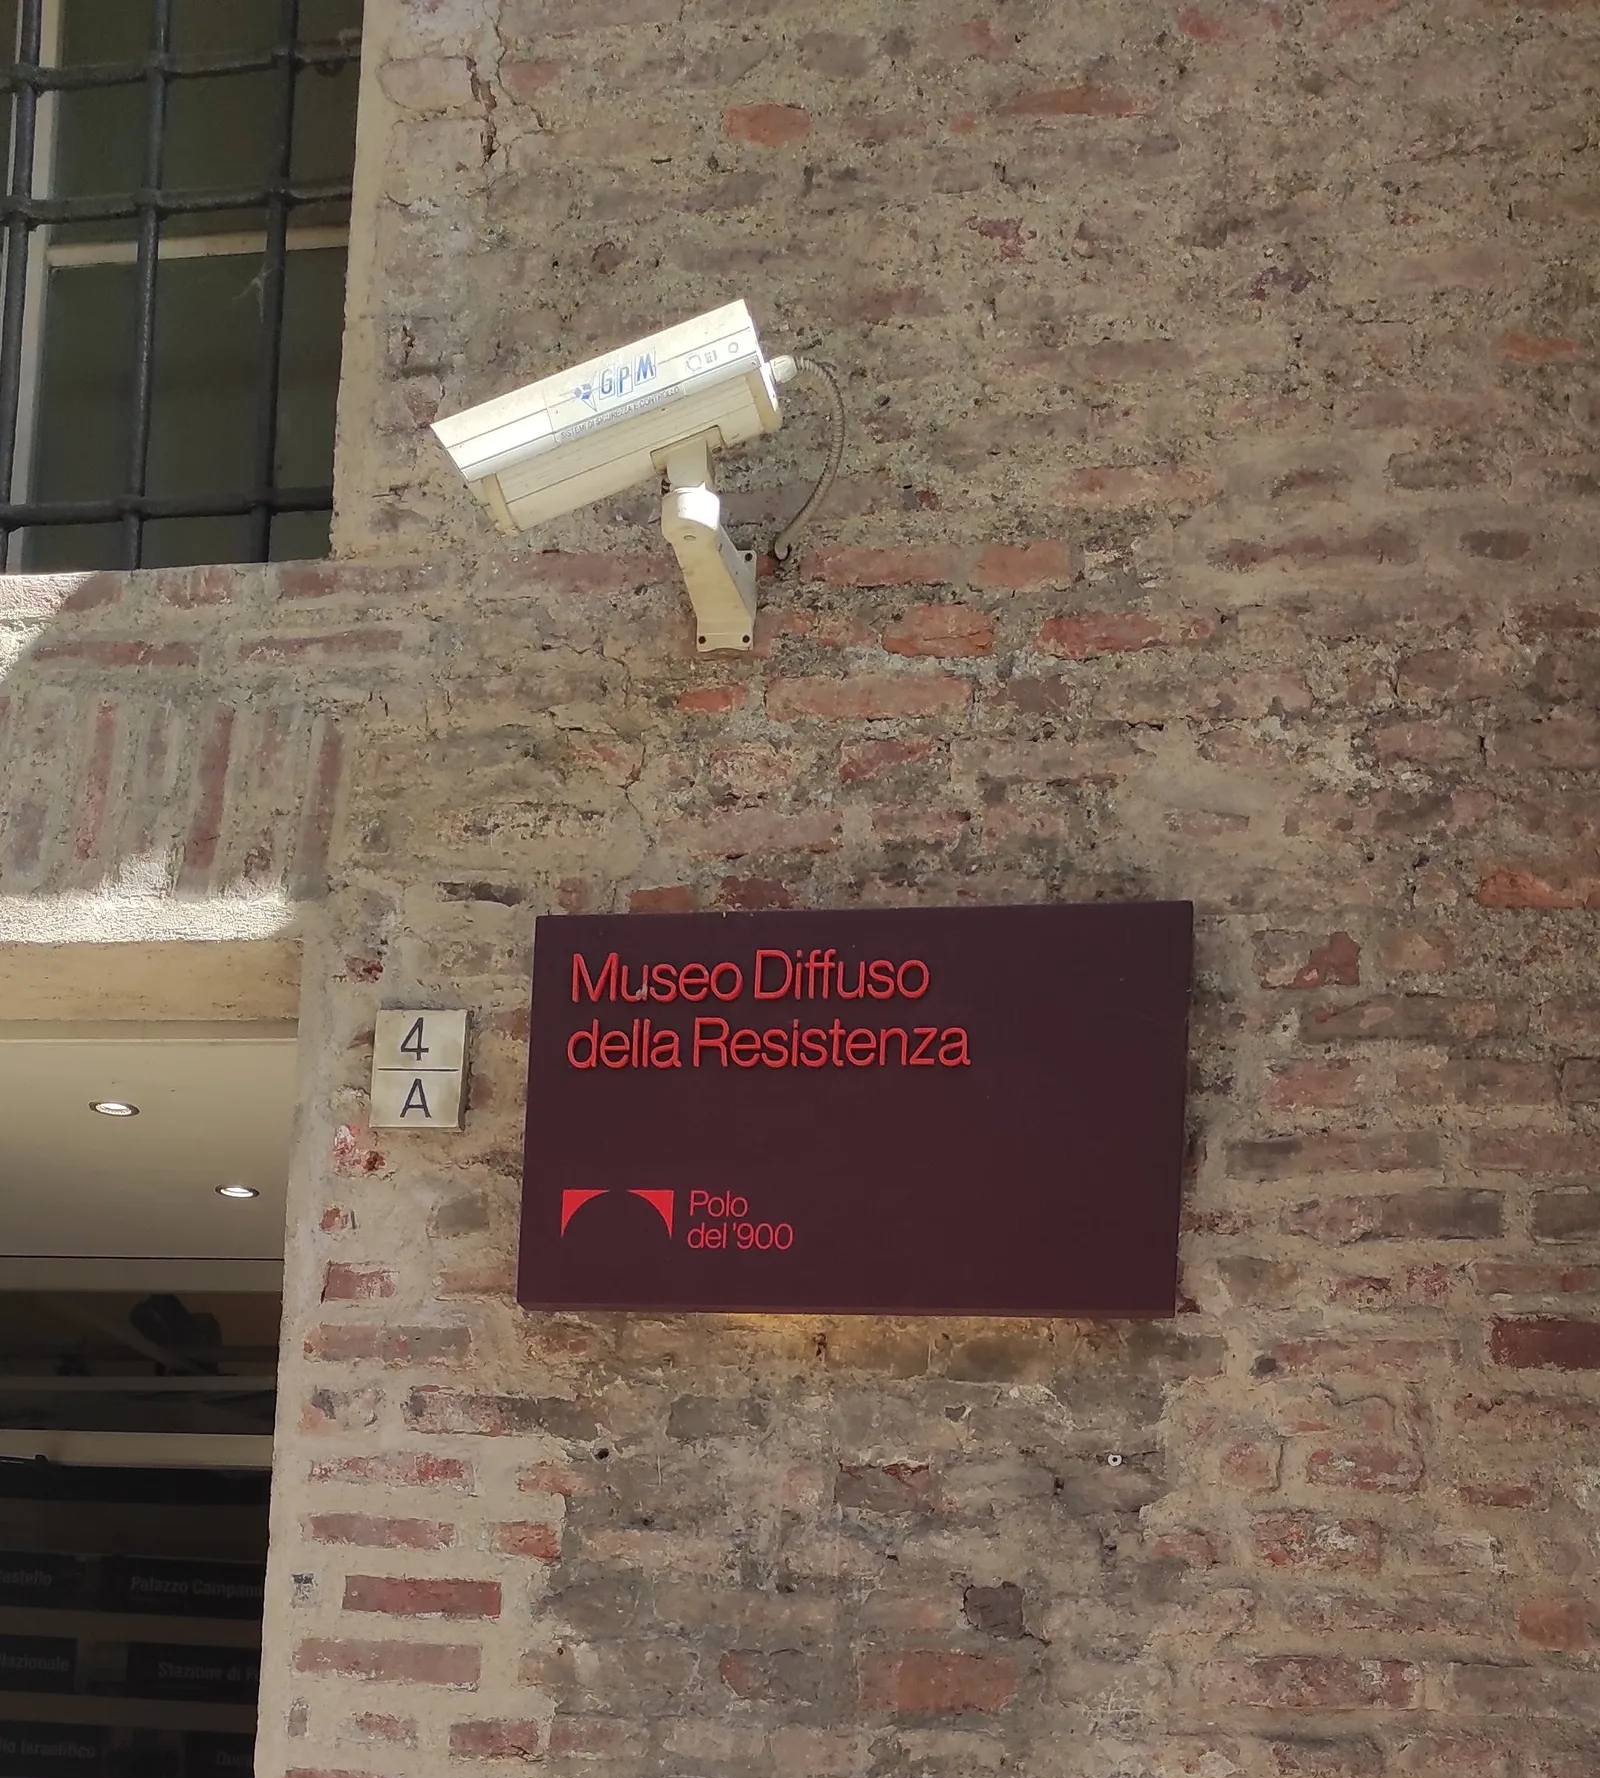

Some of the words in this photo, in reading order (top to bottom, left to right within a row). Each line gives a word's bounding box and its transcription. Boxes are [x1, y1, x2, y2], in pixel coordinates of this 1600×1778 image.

[600, 352, 656, 395] GPM
[560, 422, 587, 440] SISTEMI
[587, 418, 596, 430] DI
[596, 404, 633, 426] SICUREZZA
[572, 951, 744, 1003] Museo
[754, 948, 930, 1000] Diffuso
[400, 1017, 430, 1061] 4
[567, 1018, 682, 1068] della
[693, 1016, 971, 1067] Resistenza
[399, 1078, 432, 1118] A
[689, 1190, 748, 1218] Polo
[687, 1222, 727, 1249] del
[732, 1222, 794, 1250] '900
[130, 1575, 188, 1594] Palazzo
[157, 1660, 223, 1681] Stazione
[227, 1665, 241, 1681] di
